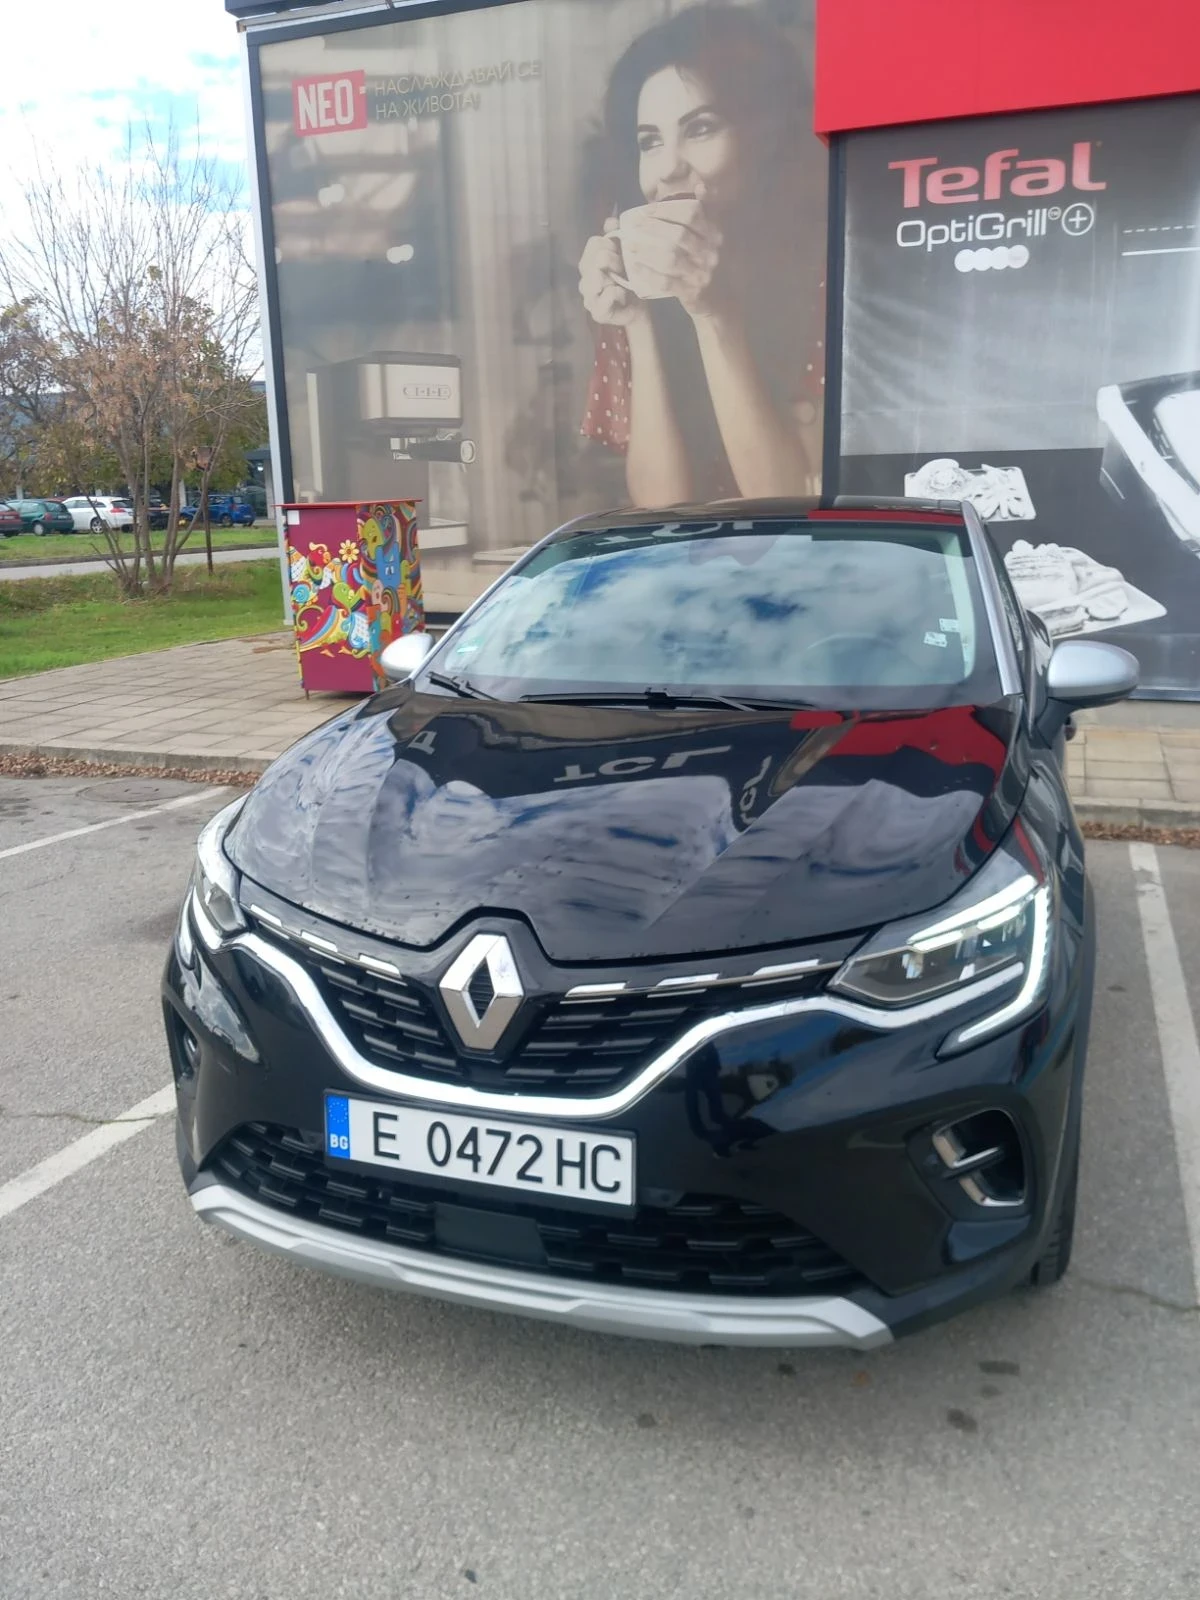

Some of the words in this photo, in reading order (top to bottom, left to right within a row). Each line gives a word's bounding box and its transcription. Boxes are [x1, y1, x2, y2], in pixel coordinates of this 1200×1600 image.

[375, 61, 512, 97] НАСЛАЖДАВАЙ
[517, 60, 542, 78] СЕ
[297, 79, 355, 130] NEO
[375, 103, 400, 121] НА
[888, 142, 1107, 208] Tefal
[330, 1132, 348, 1150] BG
[372, 1111, 400, 1160] E
[427, 1121, 543, 1184] 0472
[556, 1138, 622, 1193] HC
